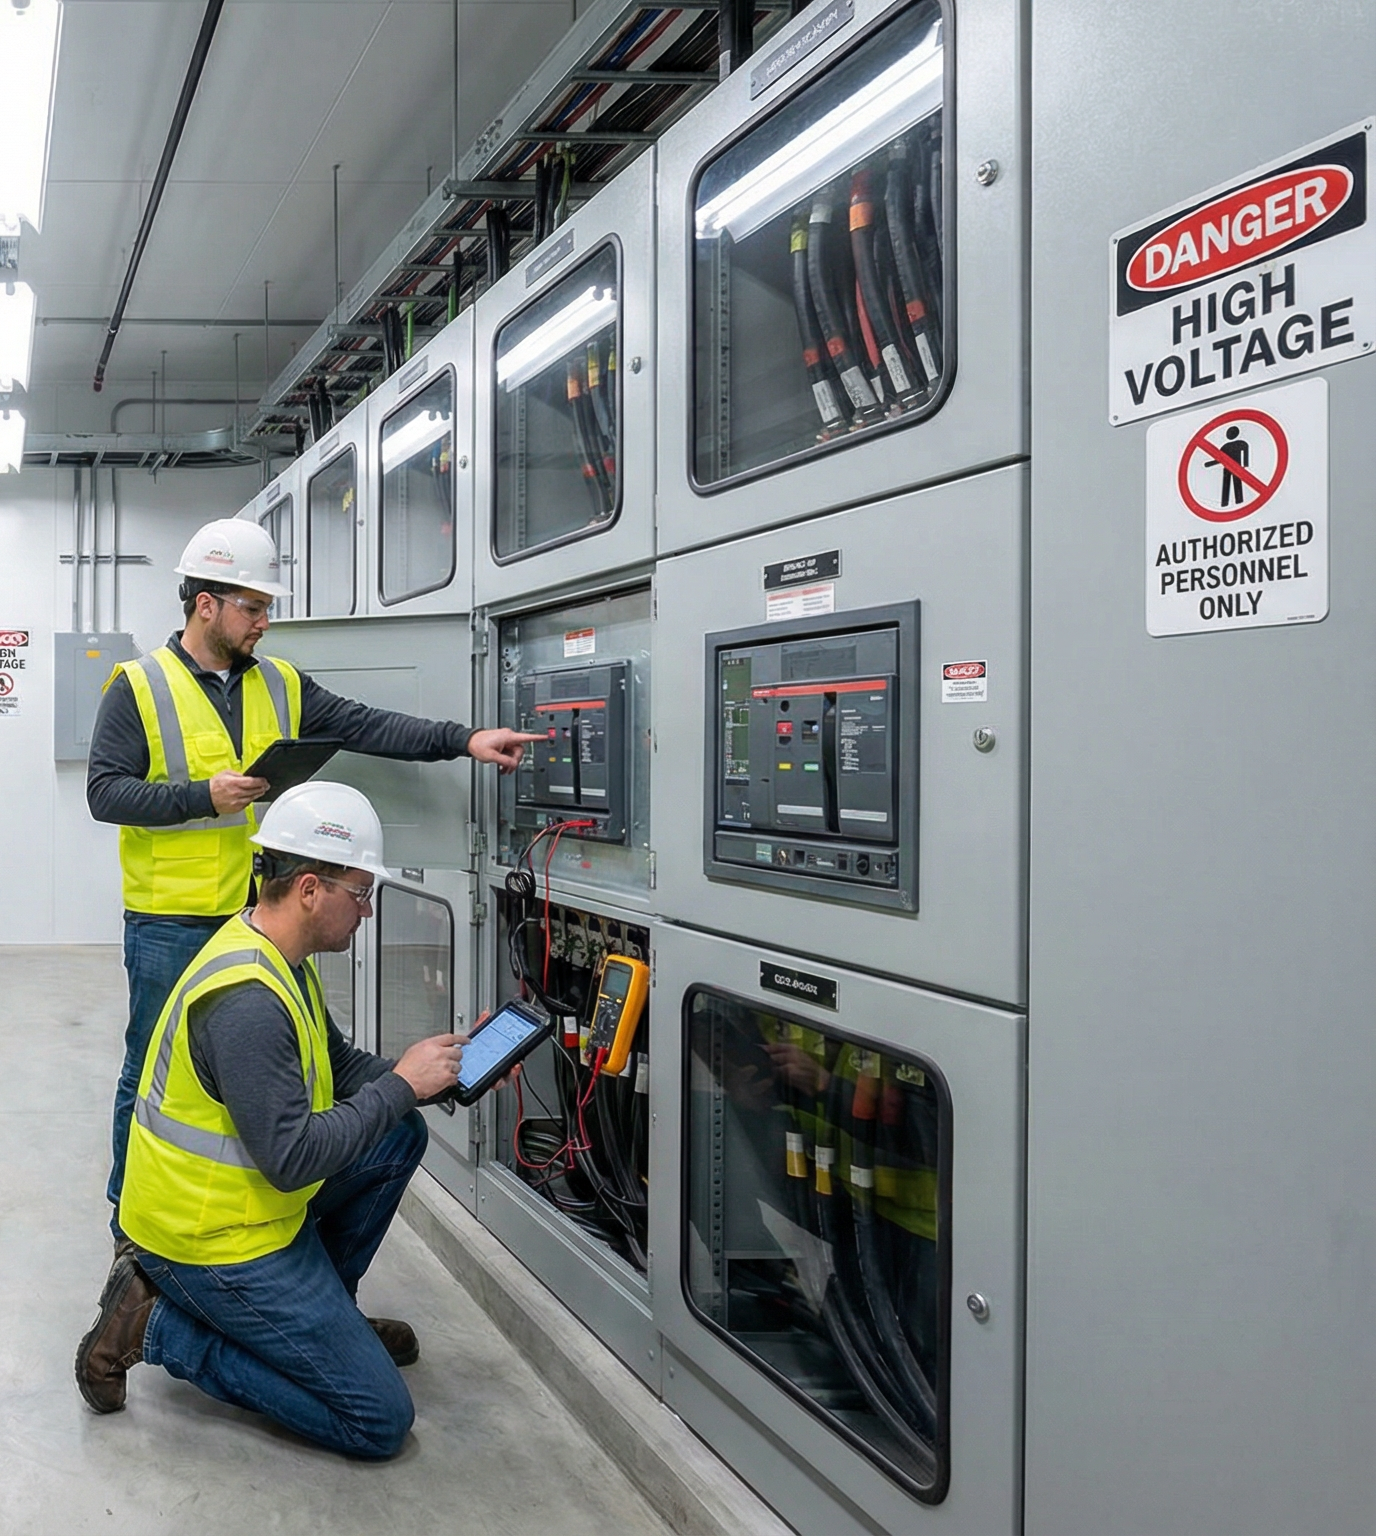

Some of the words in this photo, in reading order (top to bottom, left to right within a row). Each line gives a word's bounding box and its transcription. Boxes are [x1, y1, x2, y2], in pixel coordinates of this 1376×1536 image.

[1145, 177, 1328, 283] DANGER
[1172, 264, 1295, 345] HIGH
[1125, 297, 1354, 405] VOLTAGE
[1156, 520, 1313, 566] AUTHORIZED
[1160, 554, 1308, 595] PERSONNEL
[1199, 591, 1263, 621] ONLY
